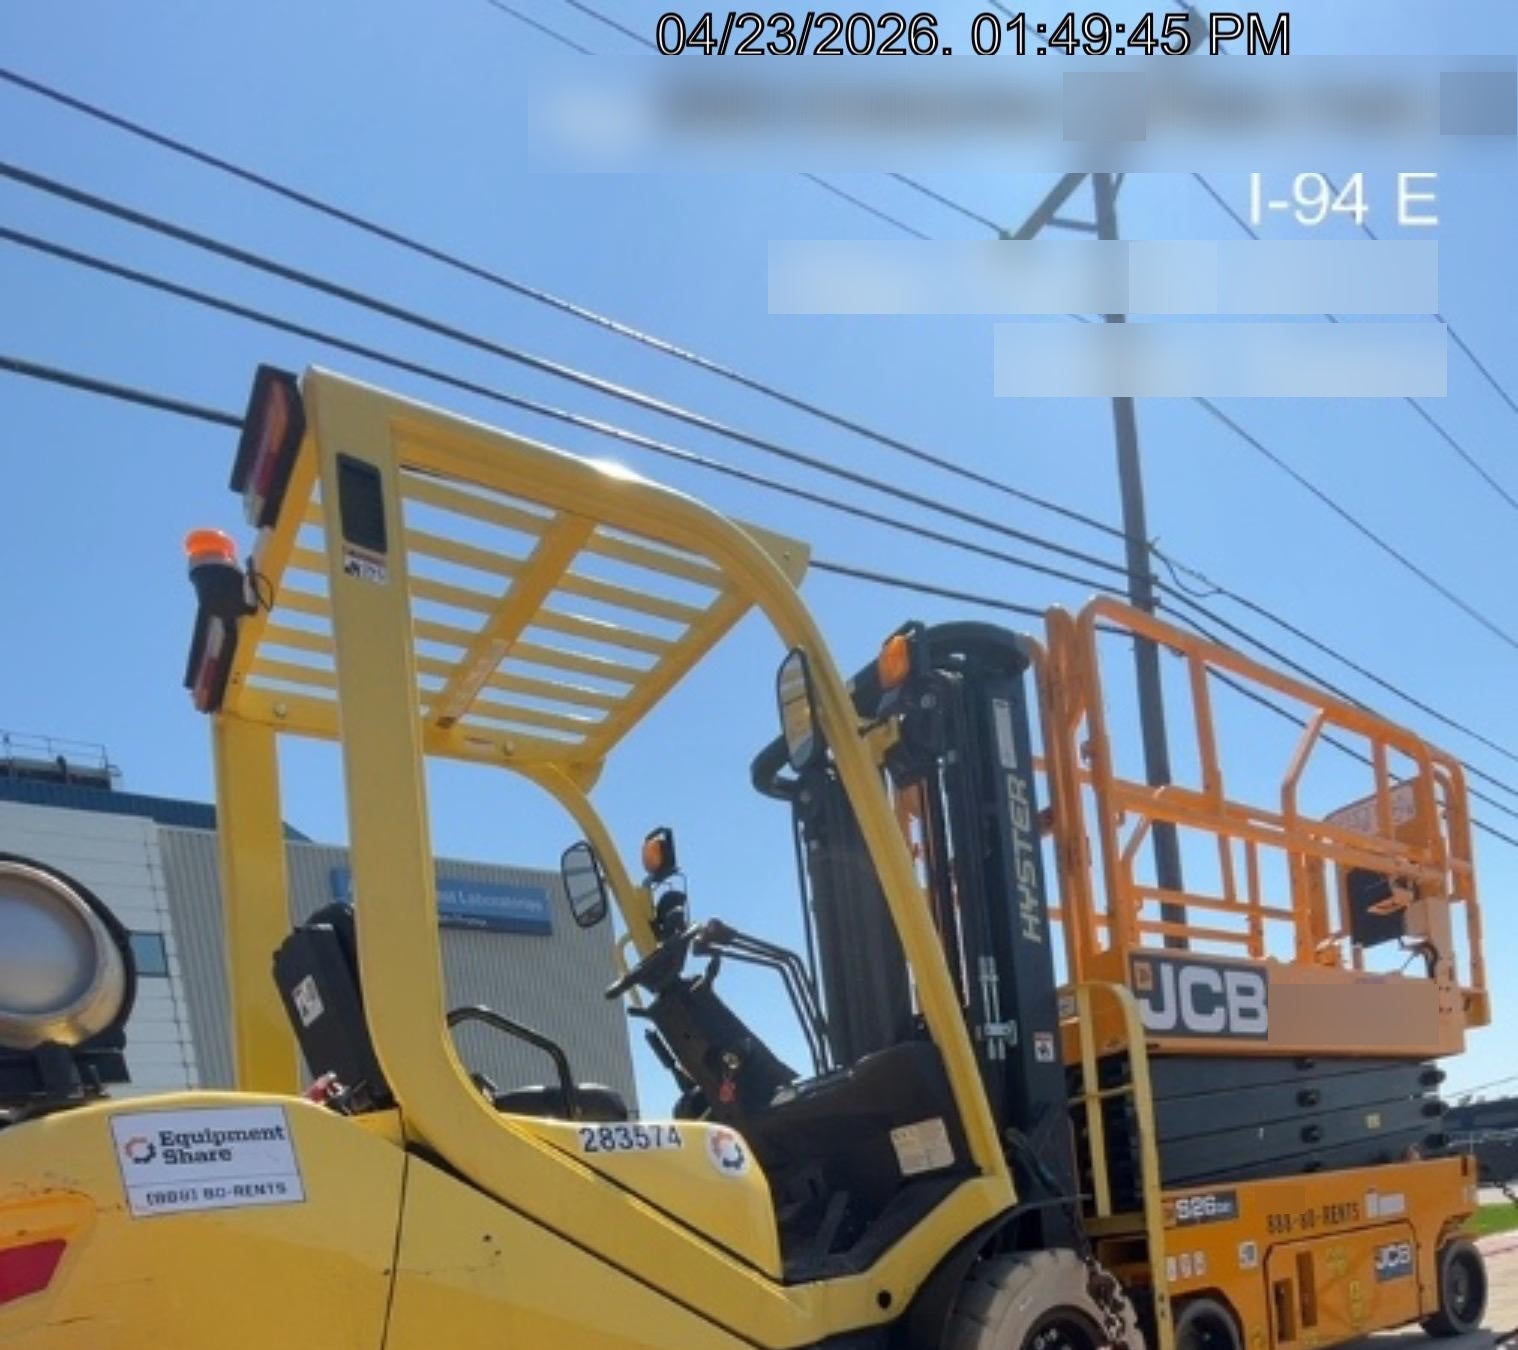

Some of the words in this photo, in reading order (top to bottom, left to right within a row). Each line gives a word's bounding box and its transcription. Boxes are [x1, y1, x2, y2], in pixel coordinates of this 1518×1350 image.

[1007, 773, 1042, 943] HYSTER
[1140, 963, 1269, 1034] JCB
[158, 1125, 285, 1148] Equipment
[579, 1125, 682, 1152] 283574
[162, 1147, 233, 1165] Share
[1376, 1244, 1411, 1270] JCB
